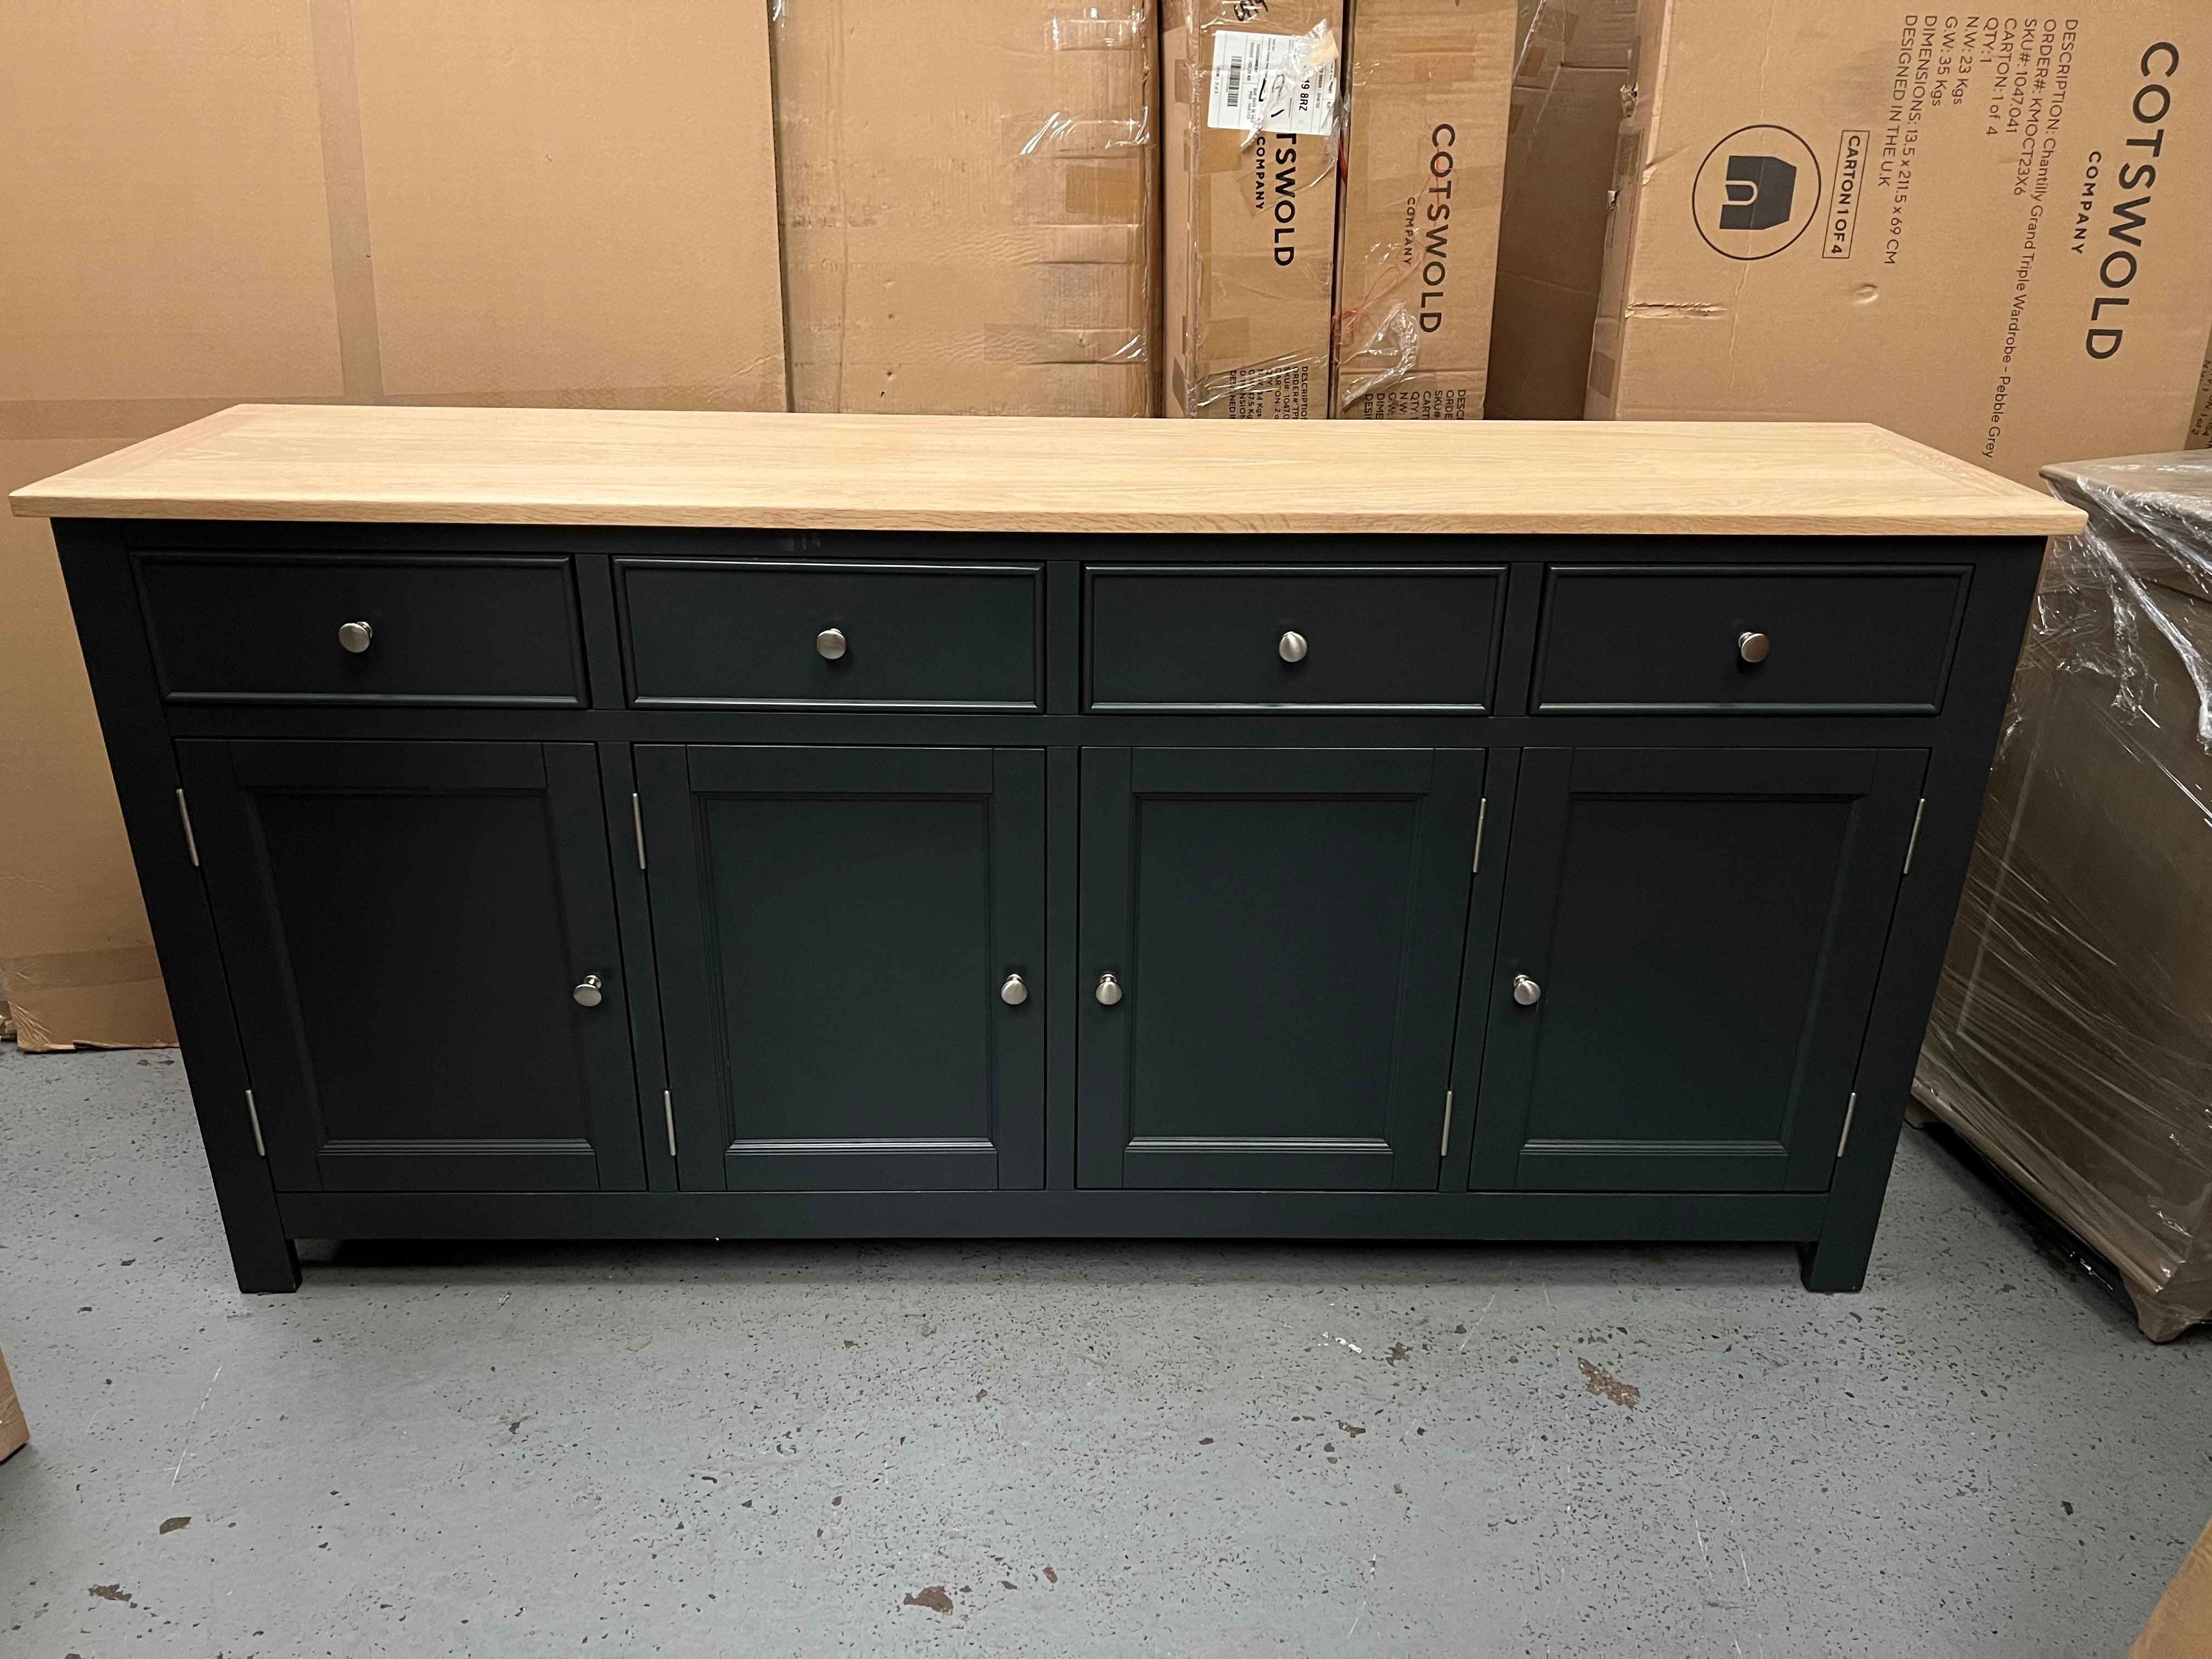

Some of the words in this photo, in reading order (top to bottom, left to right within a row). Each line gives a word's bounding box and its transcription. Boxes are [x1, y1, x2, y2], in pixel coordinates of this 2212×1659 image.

[1941, 16, 1957, 52] G.W:
[1962, 17, 1979, 52] N.W:
[1982, 18, 1998, 53] QTY:
[2017, 19, 2037, 66] SKU#:
[1893, 15, 1917, 100] DESIGNED
[1908, 16, 1937, 125] DIMENSIONS:
[1938, 57, 1951, 75] 35
[1959, 56, 1972, 73] 23
[1993, 18, 2017, 91] CARTON:
[2032, 19, 2056, 93] ORDER#:
[1931, 80, 1948, 106] Kgs
[1952, 79, 1969, 104] Kgs
[2046, 20, 2078, 133] DESCRIPTION:
[1299, 93, 1309, 111] 8RZ
[1889, 106, 1903, 121] IN
[1989, 105, 2000, 119] of
[2006, 71, 2028, 132] 1047.041
[1883, 126, 1899, 157] THE
[1903, 129, 1918, 155] 13.5
[1986, 126, 1997, 136] 4
[2014, 99, 2042, 195] KMOCT23X6
[1256, 137, 1265, 209] COMPANY
[1838, 136, 1860, 204] CARTON
[1878, 161, 1893, 186] U.K
[1895, 171, 1911, 202] 211.5
[2031, 138, 2056, 201] Chantilly
[1274, 133, 1296, 266] TSWOLD
[2070, 150, 2101, 255] COMPANY
[2085, 42, 2179, 360] COTSWOLD
[1403, 196, 1415, 266] COMPANY
[1419, 124, 1455, 333] COTSWOLD
[1834, 219, 1847, 241] OF
[1890, 218, 1903, 235] 69
[2024, 206, 2043, 249] Grand
[1831, 245, 1842, 253] 4
[1884, 239, 1899, 263] CM
[2016, 253, 2034, 291] Triple
[2003, 295, 2026, 363] Wardrobe
[1422, 391, 1431, 420] CART
[1991, 377, 2011, 422] Pebble
[1982, 427, 2000, 458] Grey
